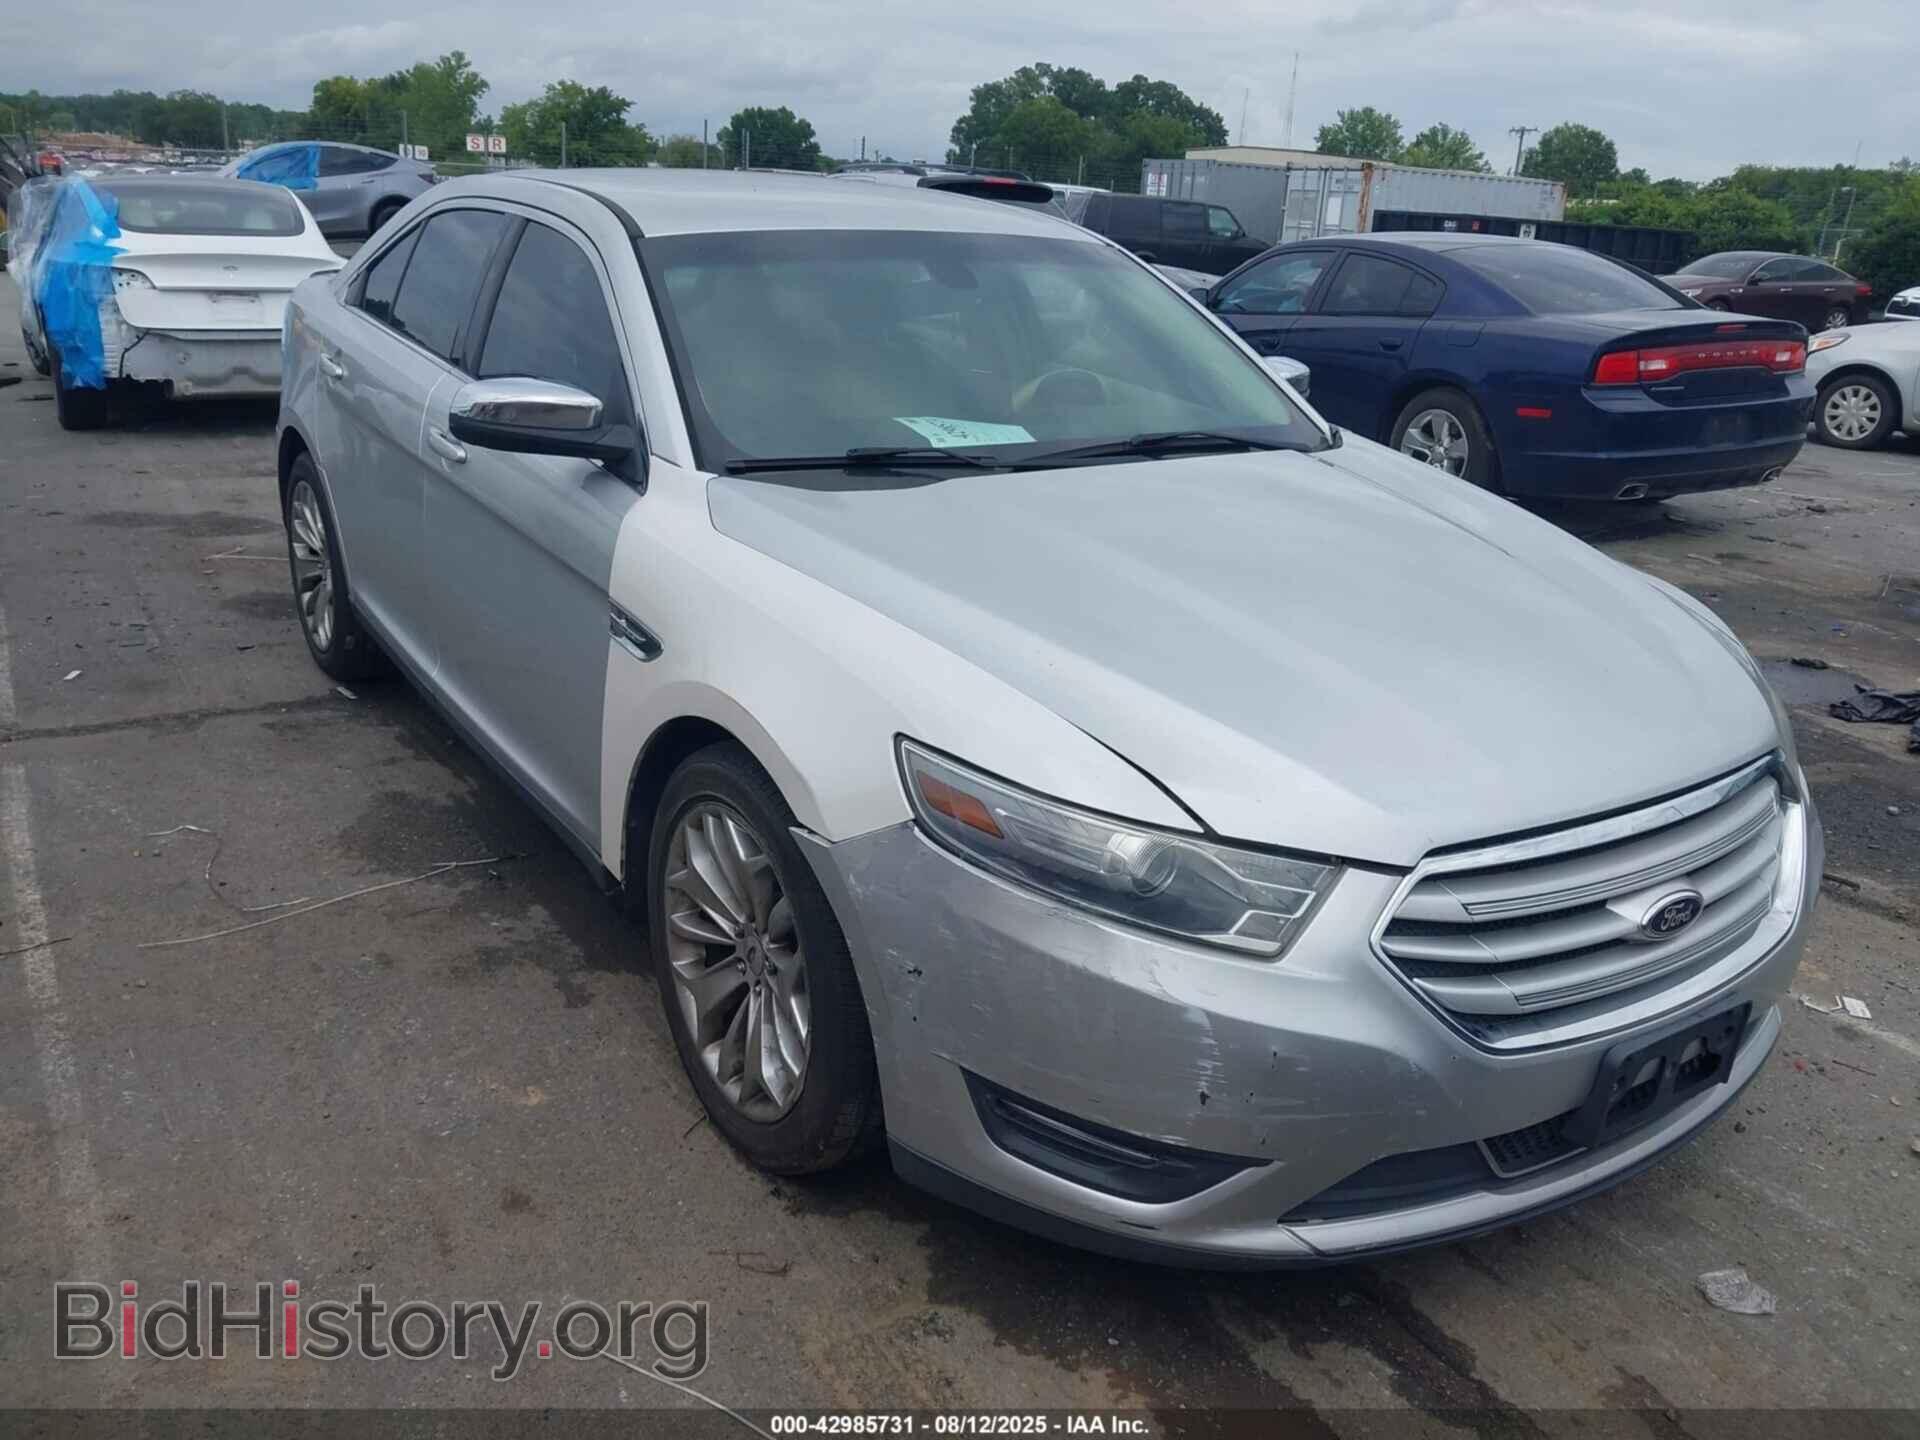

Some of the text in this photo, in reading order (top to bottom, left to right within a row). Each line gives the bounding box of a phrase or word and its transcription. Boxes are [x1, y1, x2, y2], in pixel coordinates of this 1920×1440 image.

[470, 137, 481, 149] S
[493, 139, 502, 150] R
[1660, 902, 1693, 930] Ford
